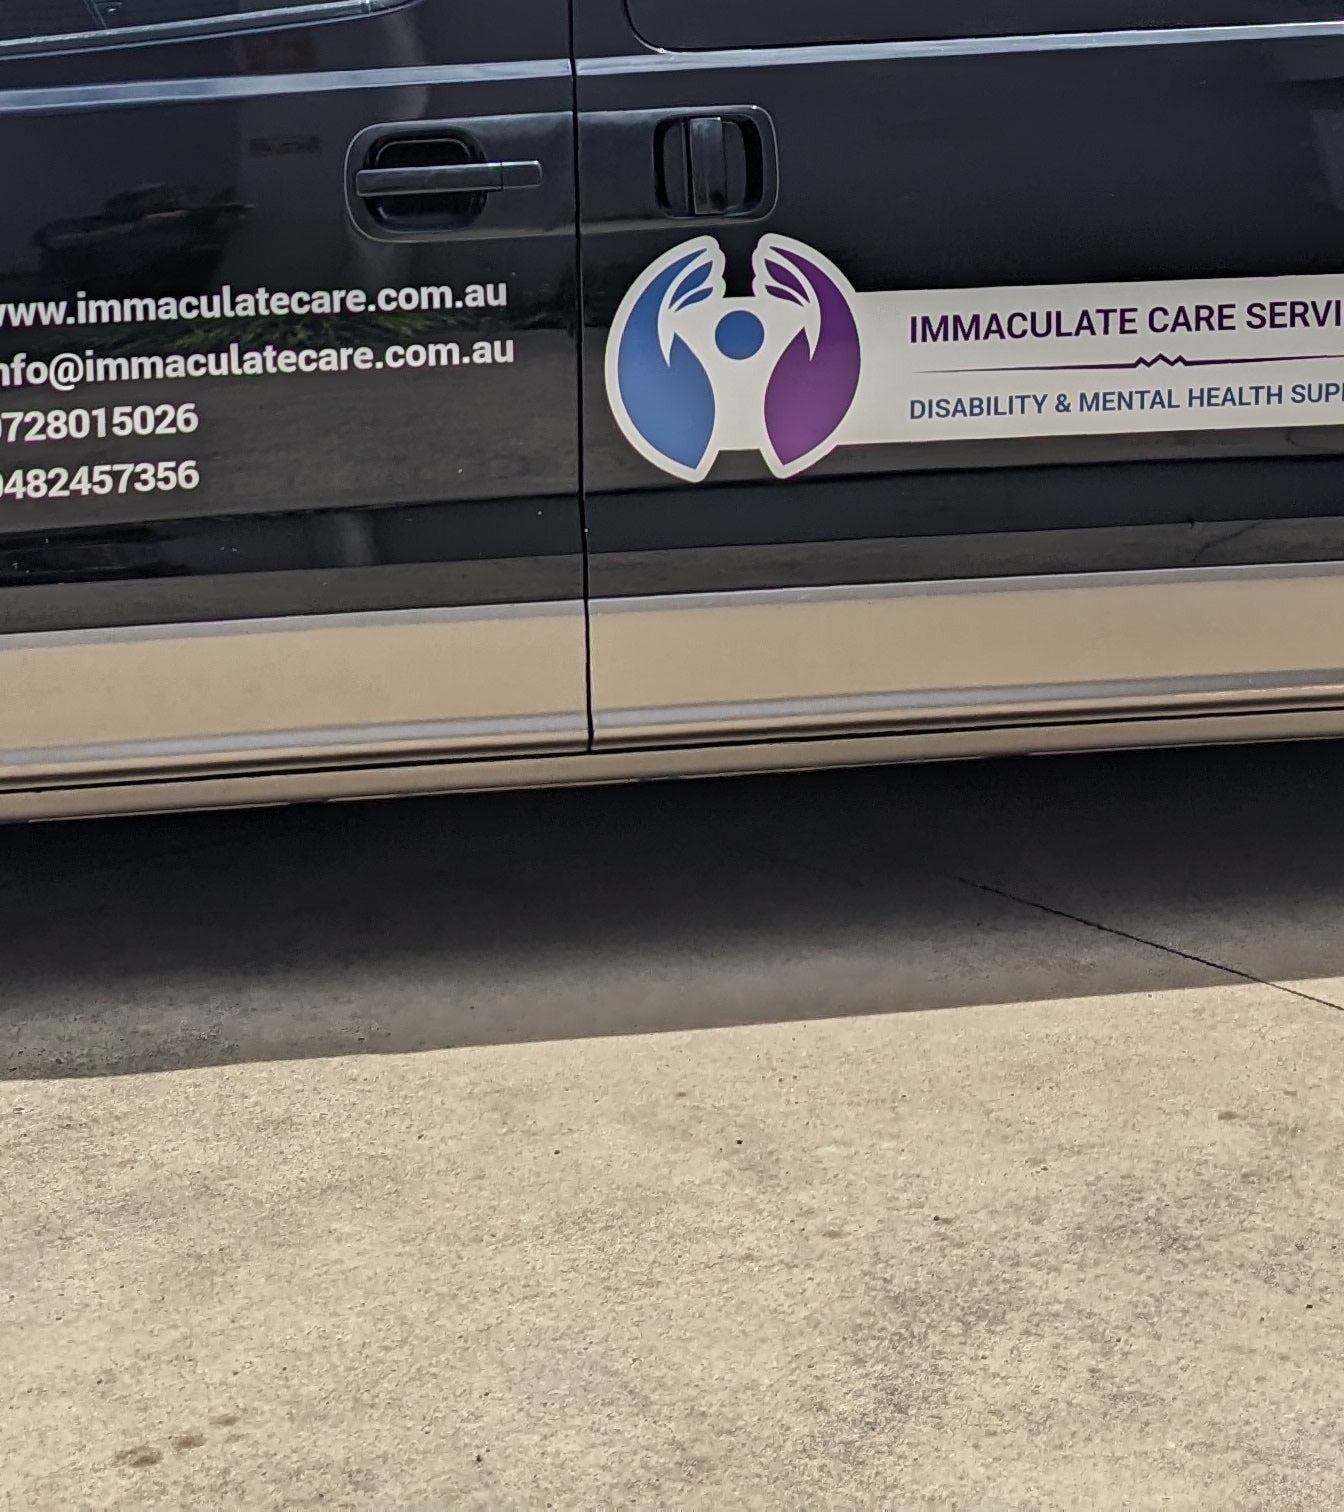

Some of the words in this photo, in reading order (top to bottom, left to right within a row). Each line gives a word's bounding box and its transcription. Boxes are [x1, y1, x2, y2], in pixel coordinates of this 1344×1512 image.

[909, 307, 1138, 343] IMMACULATE
[1147, 303, 1237, 334] CARE
[908, 393, 1048, 420] DISABILITY
[1054, 391, 1073, 414] &
[1078, 388, 1182, 413] MENTAL
[1187, 384, 1284, 409] HEALTH
